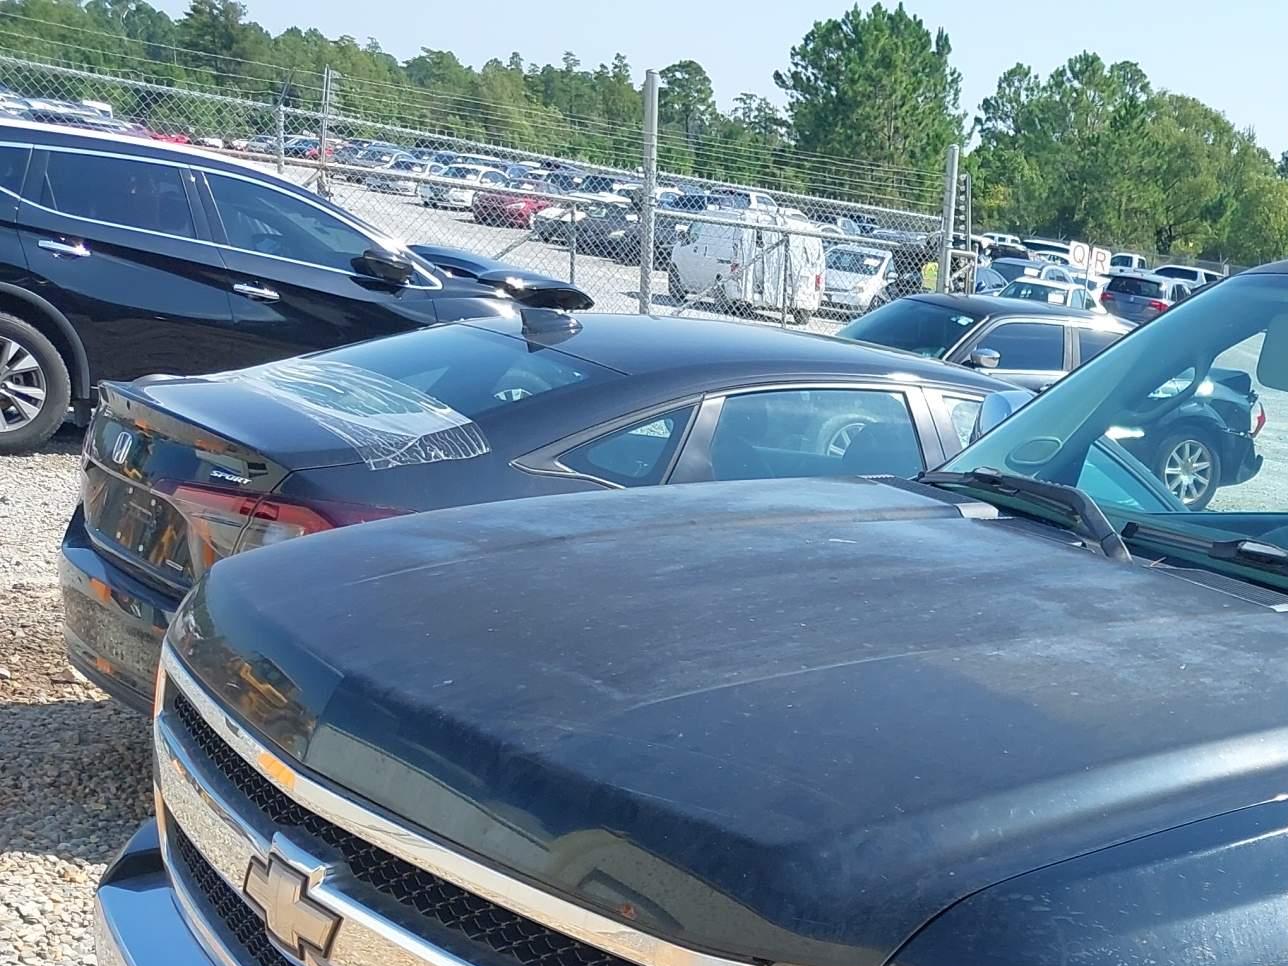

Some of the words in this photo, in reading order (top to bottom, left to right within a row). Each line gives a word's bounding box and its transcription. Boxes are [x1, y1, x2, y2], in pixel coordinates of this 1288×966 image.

[1073, 244, 1085, 266] Q
[1095, 251, 1107, 272] R
[210, 470, 253, 485] SPORT
